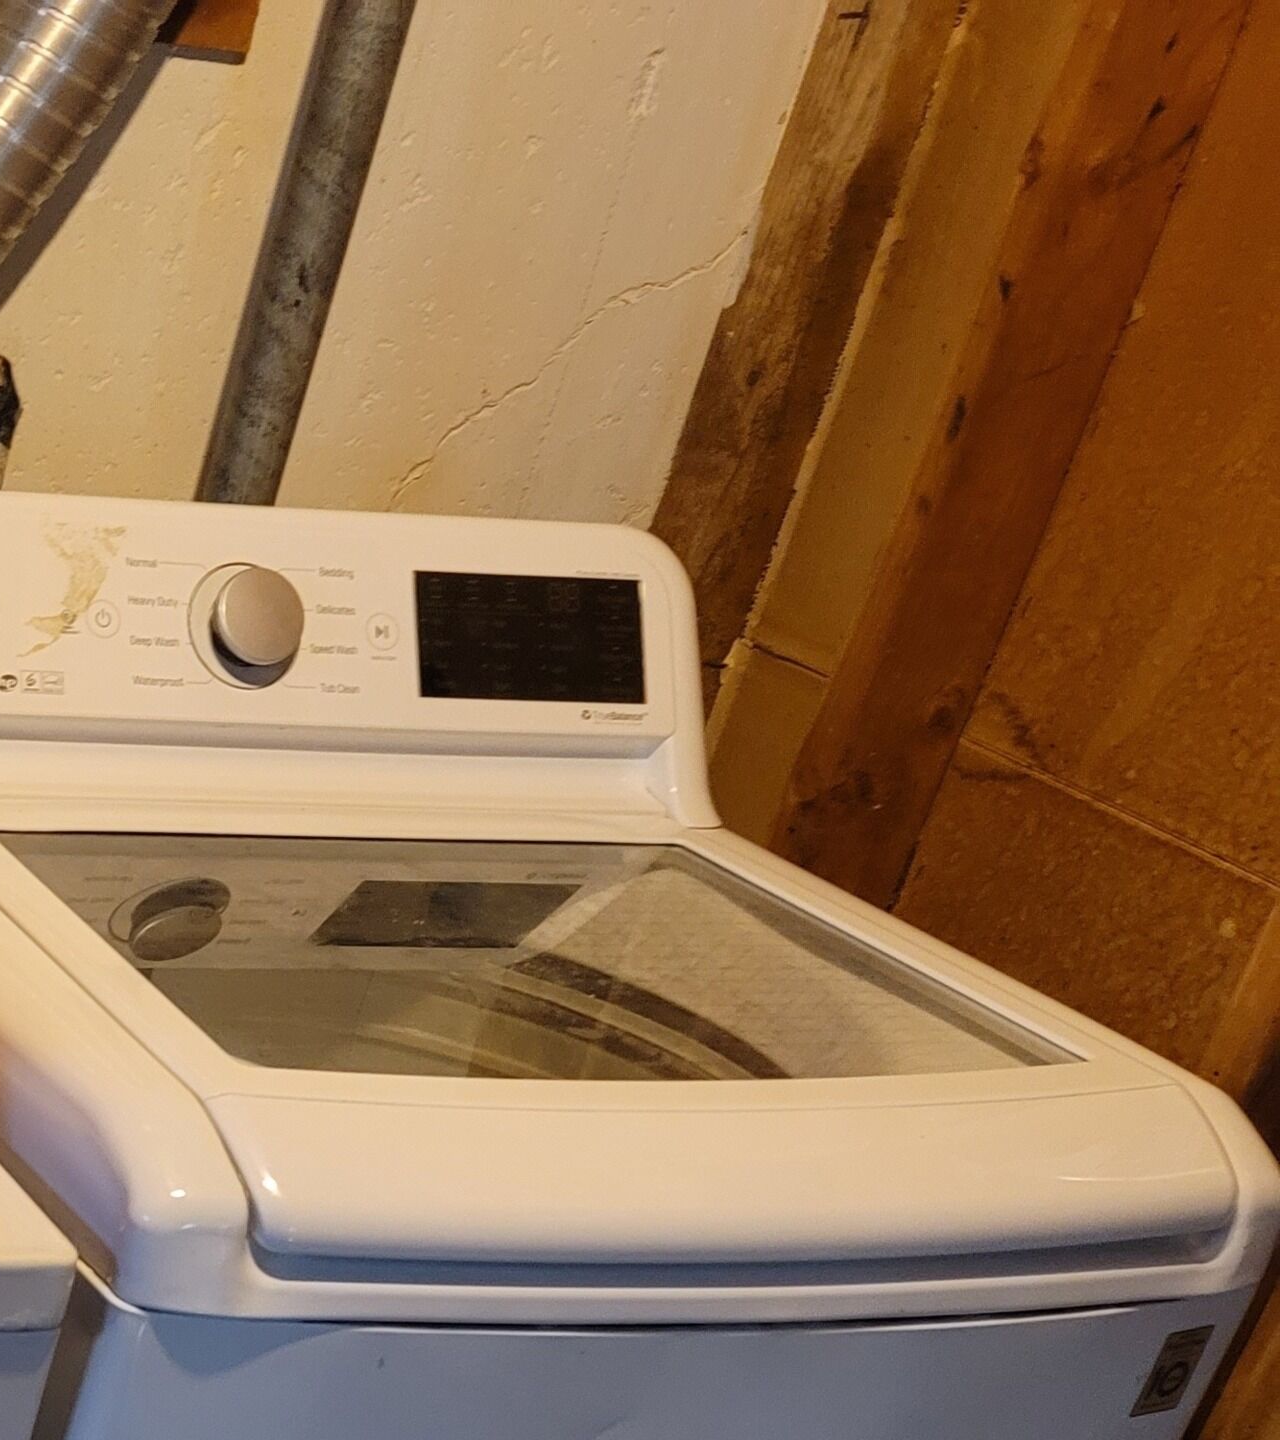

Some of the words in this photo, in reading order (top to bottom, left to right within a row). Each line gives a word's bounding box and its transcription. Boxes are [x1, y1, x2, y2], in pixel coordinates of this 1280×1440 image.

[125, 557, 158, 568] Normal
[319, 567, 355, 580] Bedding
[127, 596, 156, 608] Heavy
[156, 597, 178, 609] Duty
[315, 604, 357, 616] Delicates
[129, 635, 153, 647] Deep
[154, 637, 180, 647] Wash
[309, 643, 335, 655] Speed
[336, 645, 359, 655] Wash
[132, 675, 185, 688] Waterproof
[337, 684, 360, 694] Clean
